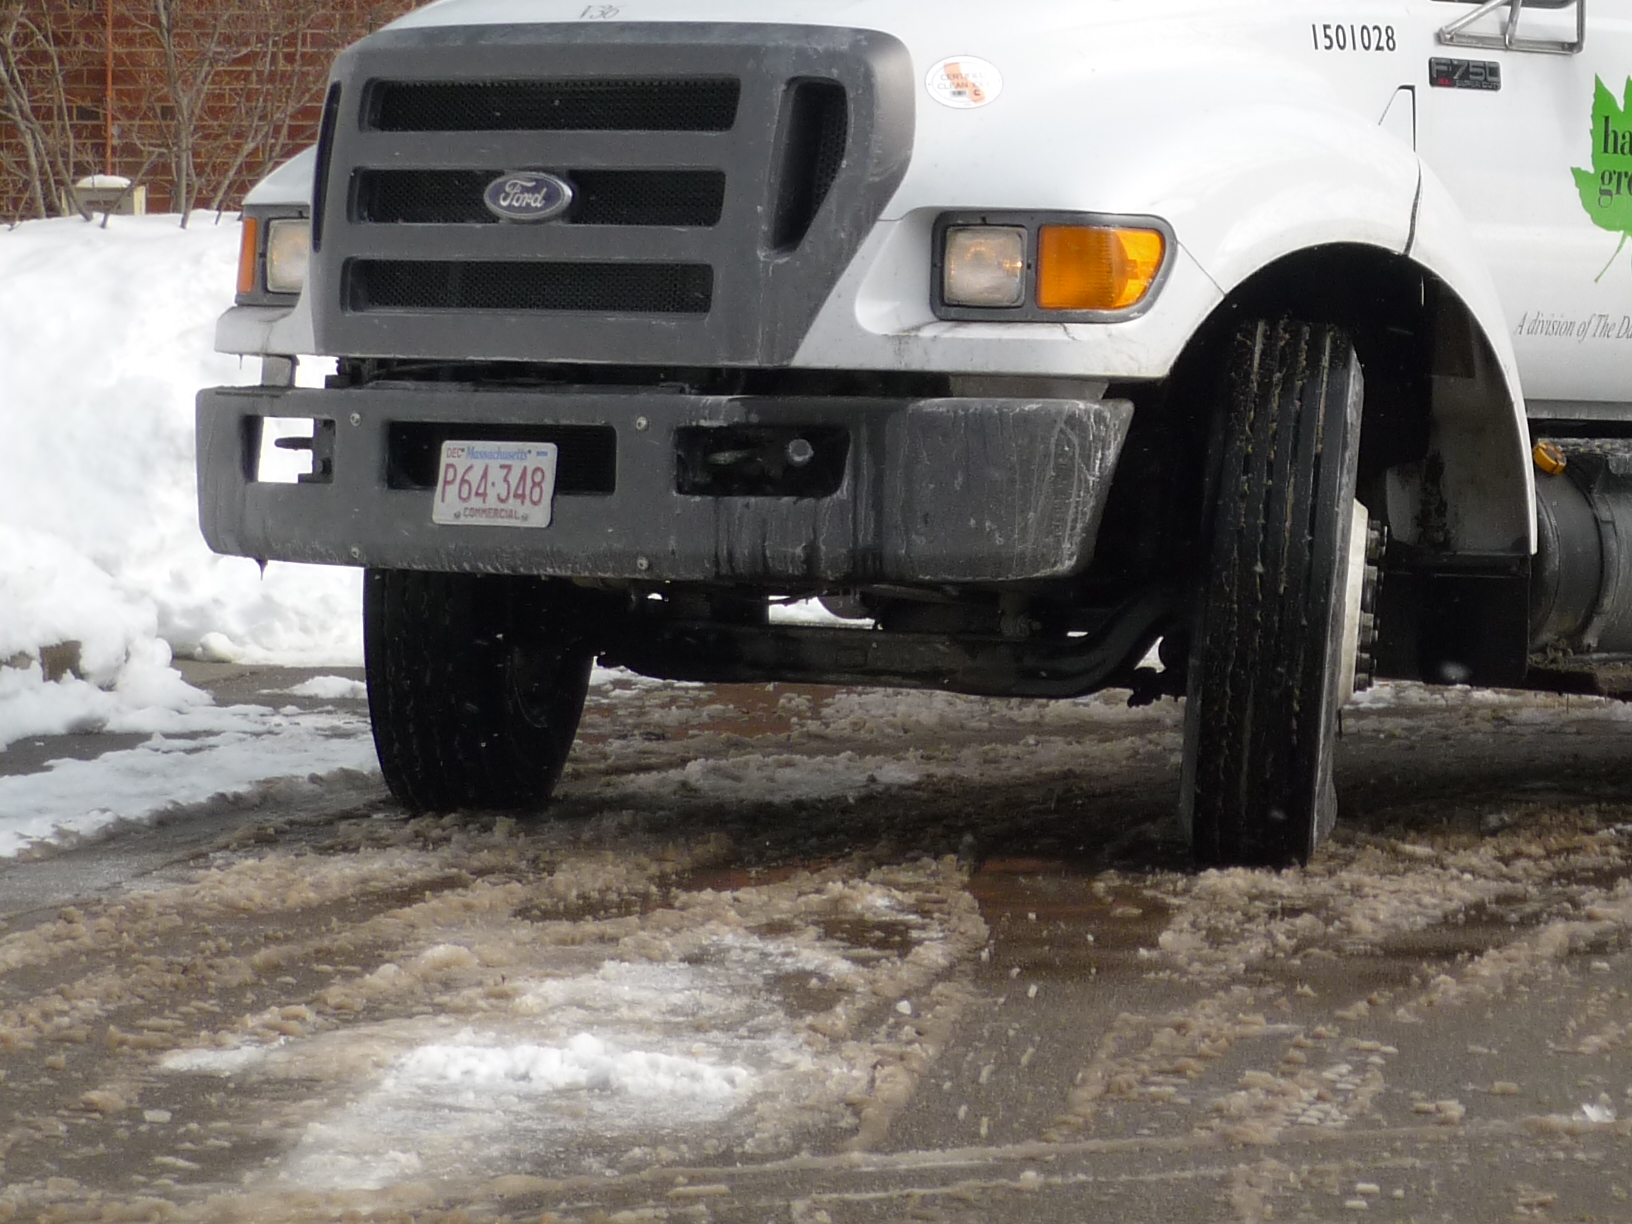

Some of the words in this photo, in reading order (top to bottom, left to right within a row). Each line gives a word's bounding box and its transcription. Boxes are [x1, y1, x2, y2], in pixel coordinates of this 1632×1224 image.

[1312, 23, 1396, 51] 1501028
[500, 179, 547, 207] Ford
[1514, 311, 1528, 336] A
[1526, 311, 1576, 337] division
[1577, 313, 1597, 343] of
[1592, 314, 1616, 338] The
[466, 446, 528, 460] Massachusetts
[463, 507, 520, 520] COMMERCIAL
